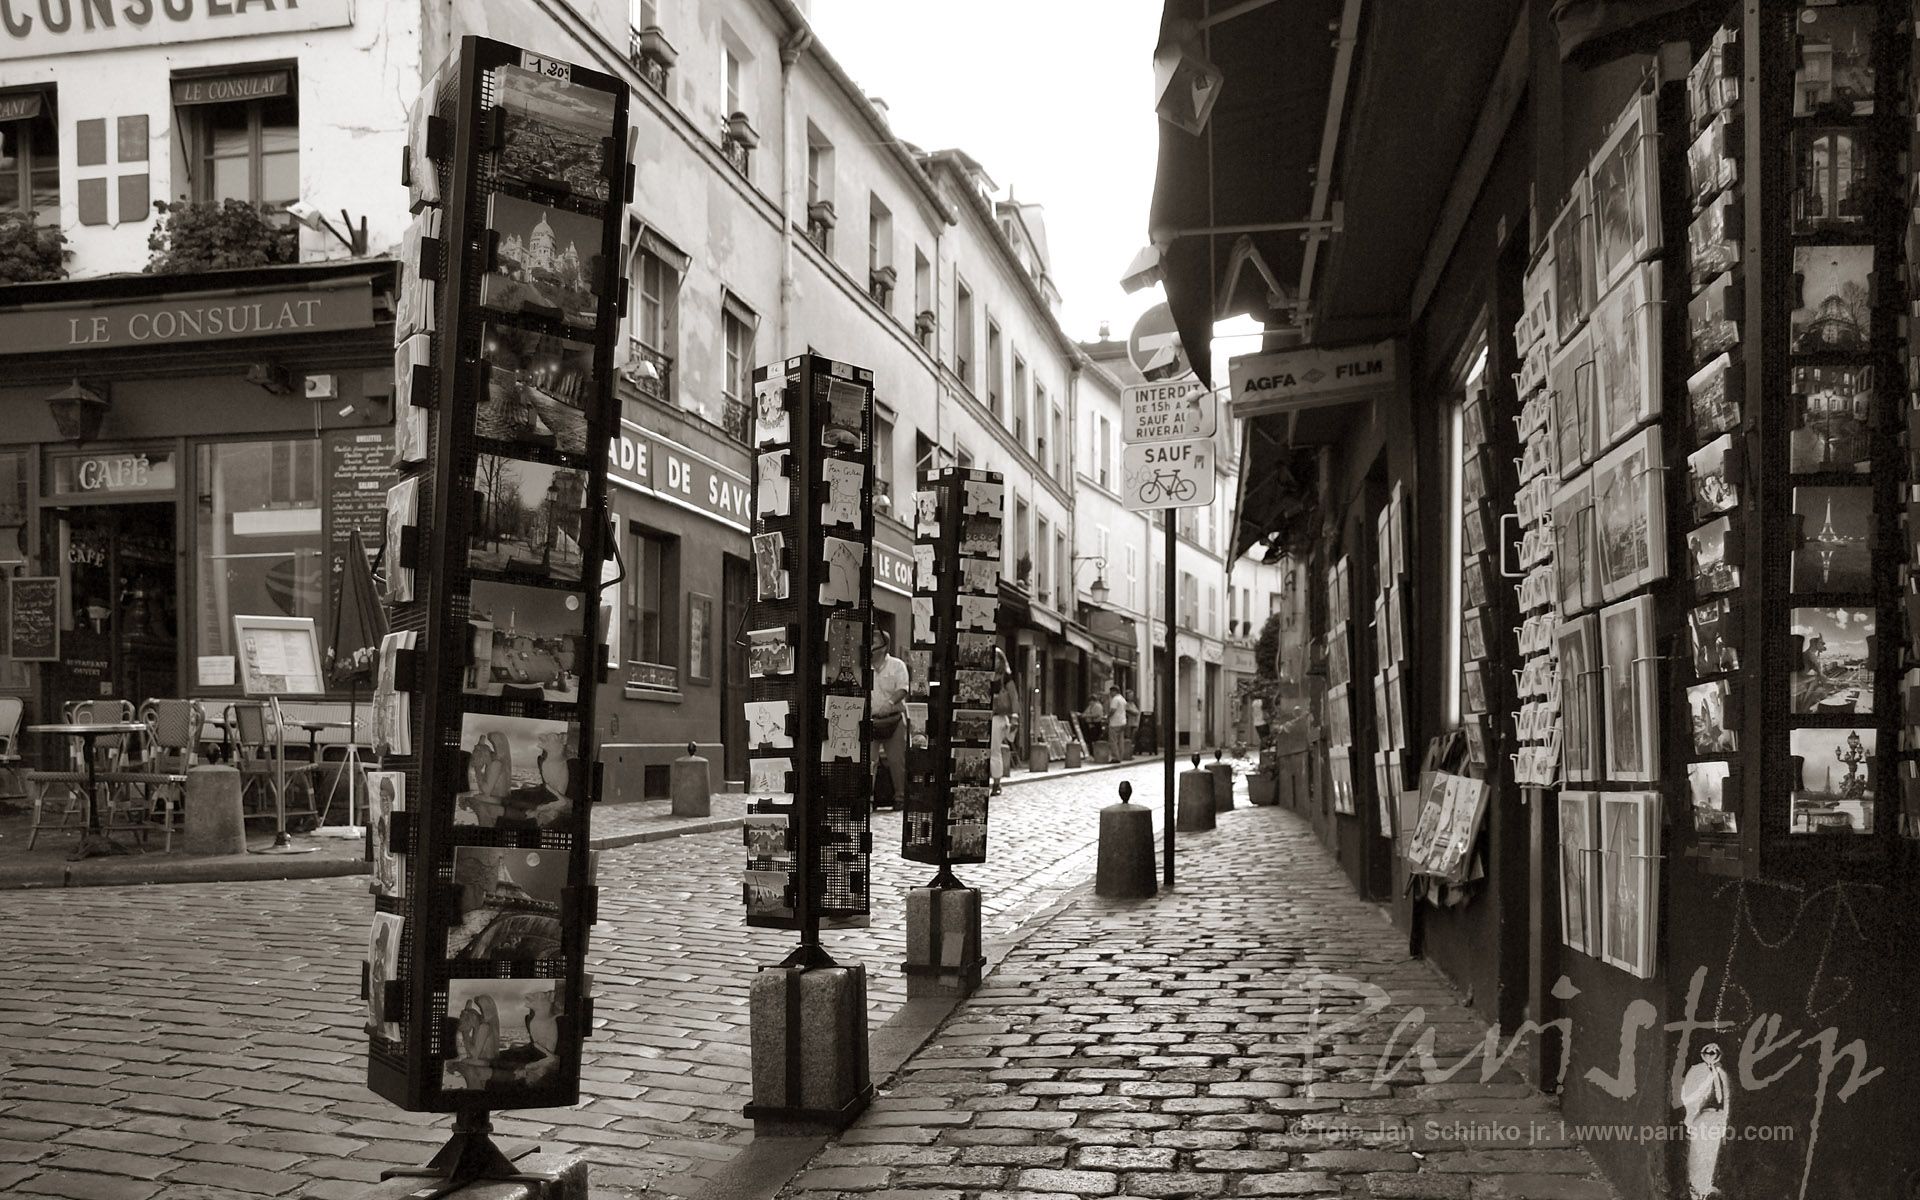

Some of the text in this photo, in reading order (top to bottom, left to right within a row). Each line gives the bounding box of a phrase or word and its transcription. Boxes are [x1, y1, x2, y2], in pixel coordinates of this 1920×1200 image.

[184, 76, 279, 101] LE CONSULAT
[69, 299, 321, 345] LE CONSULAT
[1244, 373, 1297, 392] AGFA
[1335, 360, 1382, 379] FILM
[1136, 405, 1147, 414] DE
[1151, 401, 1170, 412] 15h
[1139, 413, 1169, 426] SAUF
[1144, 445, 1192, 463] SAUF
[79, 453, 149, 489] CAFÉ
[668, 455, 691, 494] DE
[879, 553, 890, 579] LE
